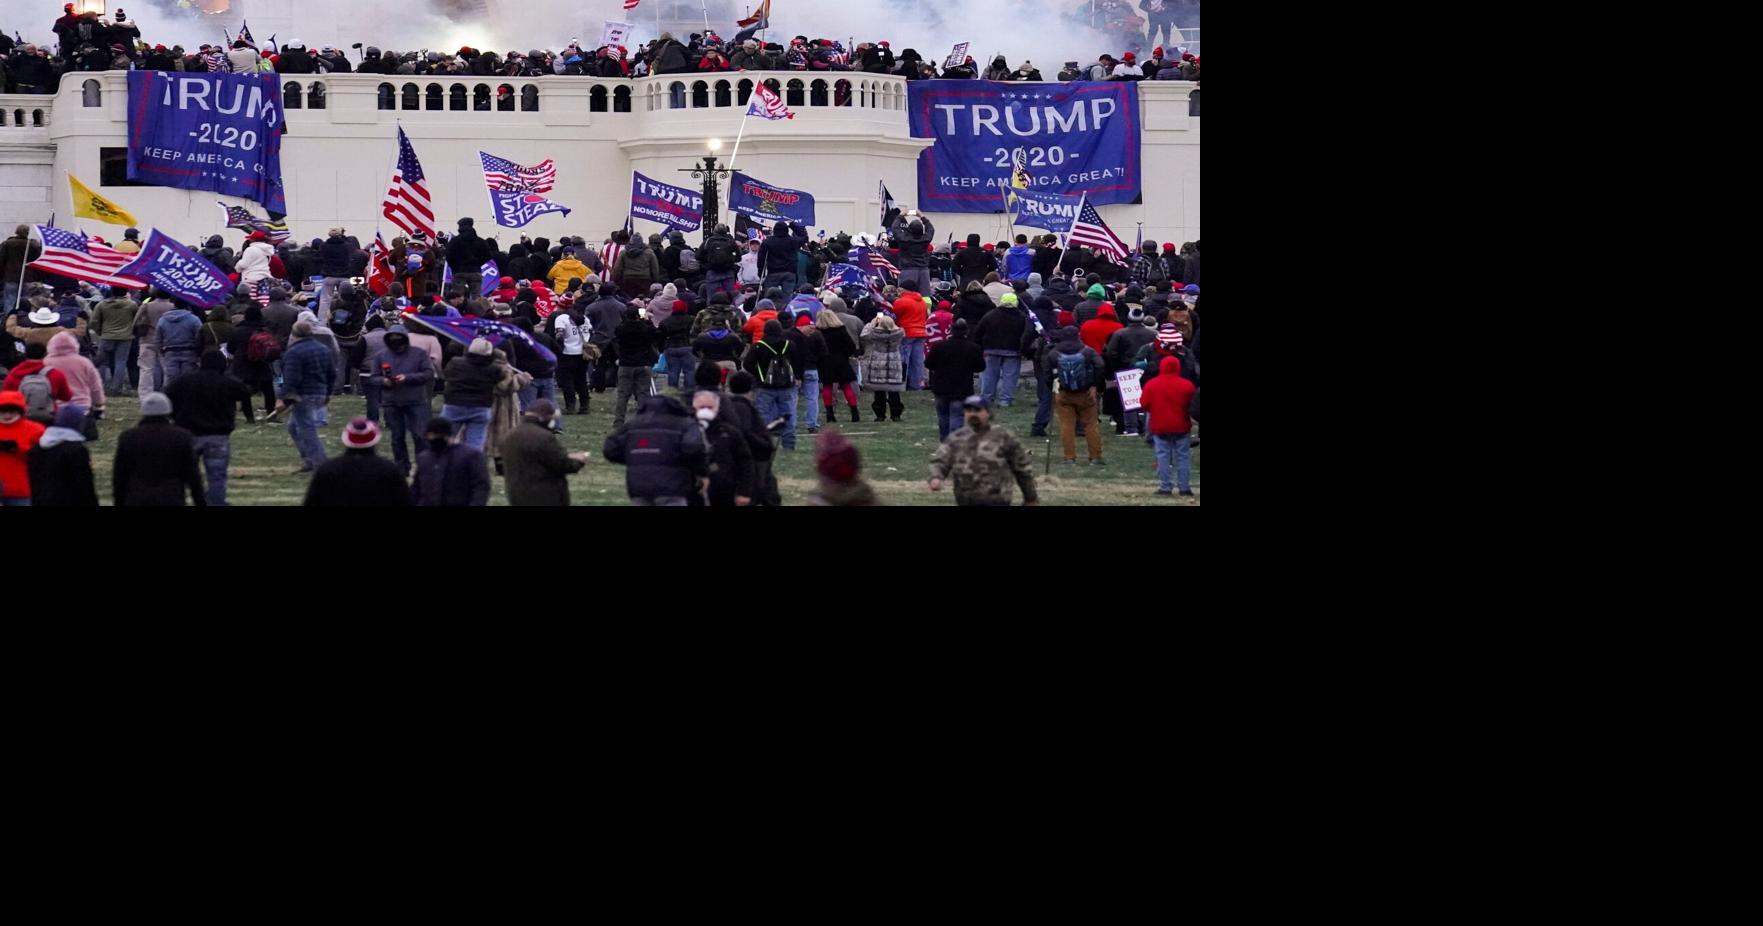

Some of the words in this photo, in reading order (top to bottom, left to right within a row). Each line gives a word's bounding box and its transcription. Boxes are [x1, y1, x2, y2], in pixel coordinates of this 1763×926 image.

[934, 97, 1117, 137] TRUMP
[144, 146, 182, 161] KEEP
[186, 152, 246, 171] AMECA
[940, 175, 980, 187] KEEP
[986, 173, 1062, 188] AMICA
[1068, 167, 1125, 184] GREAT!
[637, 178, 703, 210] TRUMP
[742, 183, 800, 206] TRUMP
[646, 208, 670, 220] MORE
